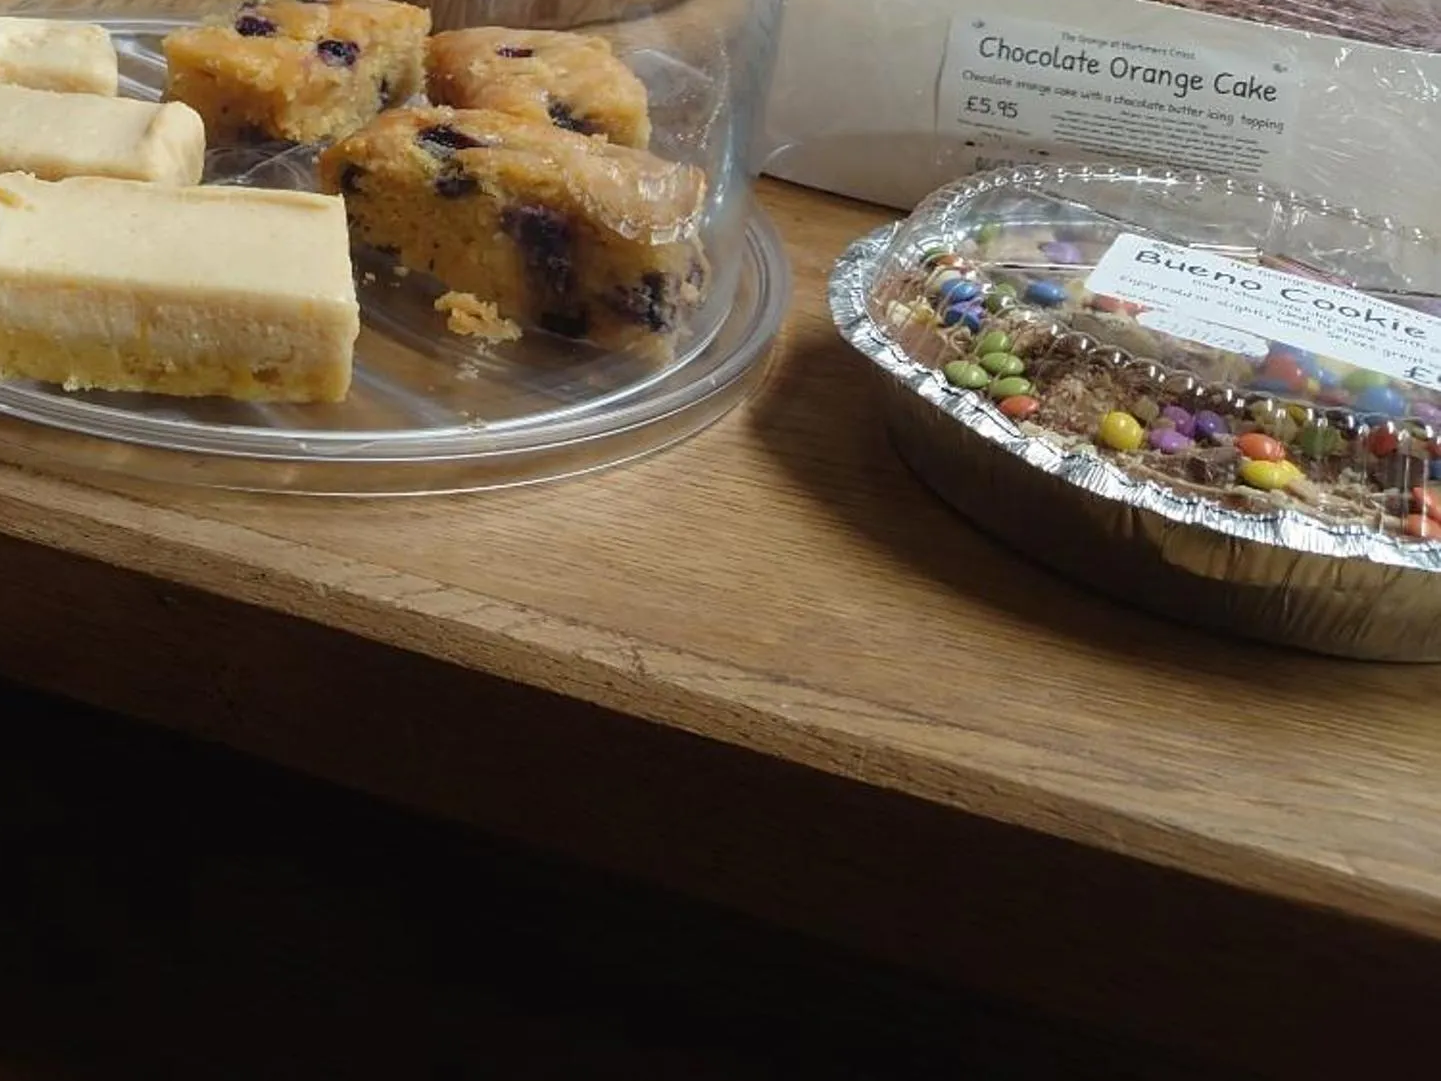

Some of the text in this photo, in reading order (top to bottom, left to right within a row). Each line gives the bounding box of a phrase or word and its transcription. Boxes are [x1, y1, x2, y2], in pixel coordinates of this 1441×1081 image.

[979, 36, 1277, 101] Chocolate Orange Cake
[962, 70, 1012, 86] Chocolate
[1080, 90, 1103, 101] with
[1114, 95, 1165, 112] chocolate
[1168, 103, 1205, 118] butter
[1207, 109, 1234, 126] icing
[1241, 114, 1284, 134] topping
[964, 95, 1019, 119] £5.95
[1134, 250, 1262, 290] Bueno
[1280, 288, 1426, 340] Cookie
